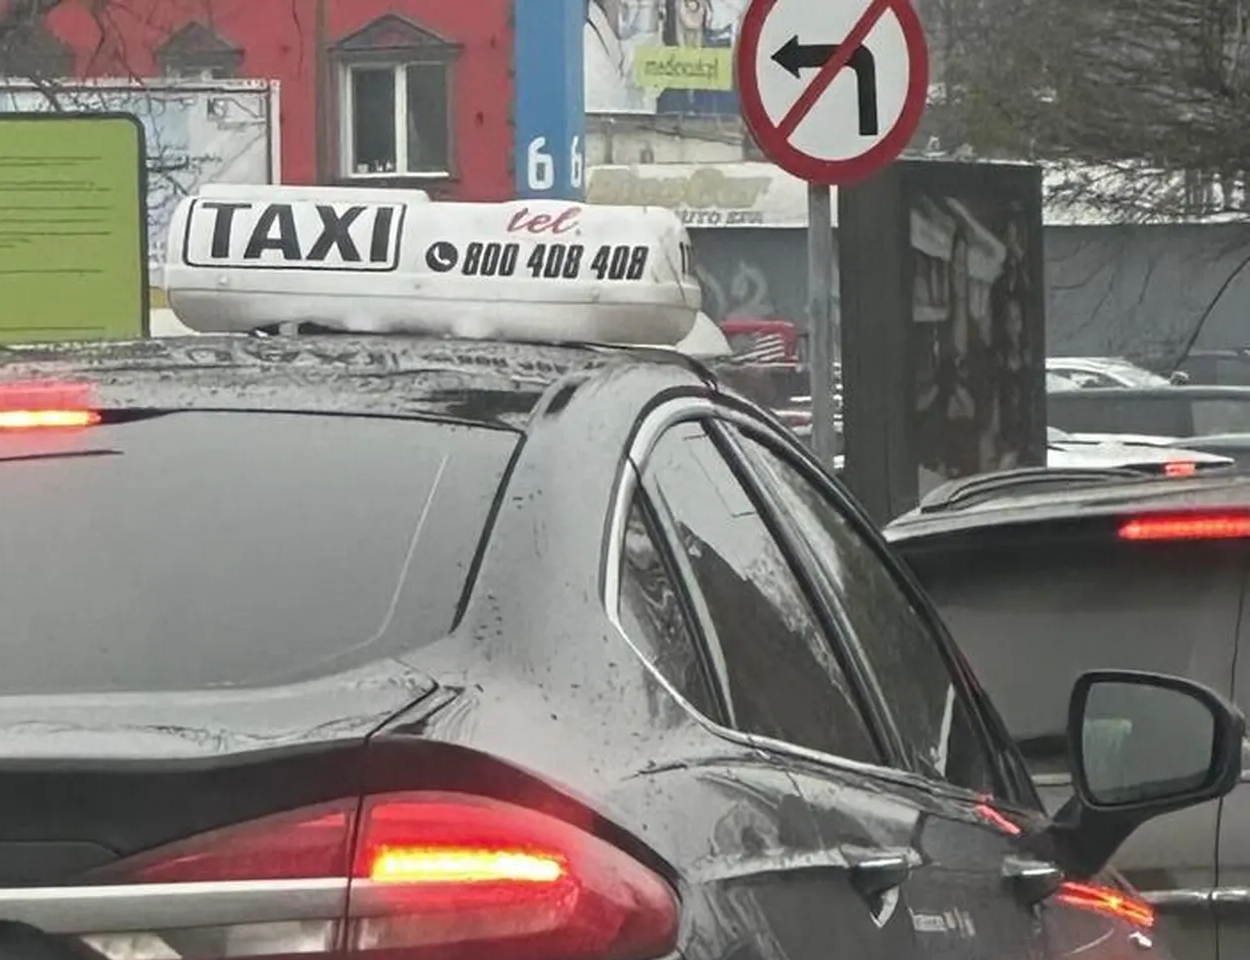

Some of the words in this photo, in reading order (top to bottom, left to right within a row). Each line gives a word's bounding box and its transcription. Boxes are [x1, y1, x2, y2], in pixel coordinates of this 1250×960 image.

[528, 136, 554, 190] 6
[202, 201, 393, 263] TAXI
[506, 207, 582, 235] tel.
[675, 210, 721, 225] UTO
[461, 241, 520, 277] 800
[526, 243, 584, 280] 408
[590, 245, 649, 281] 408
